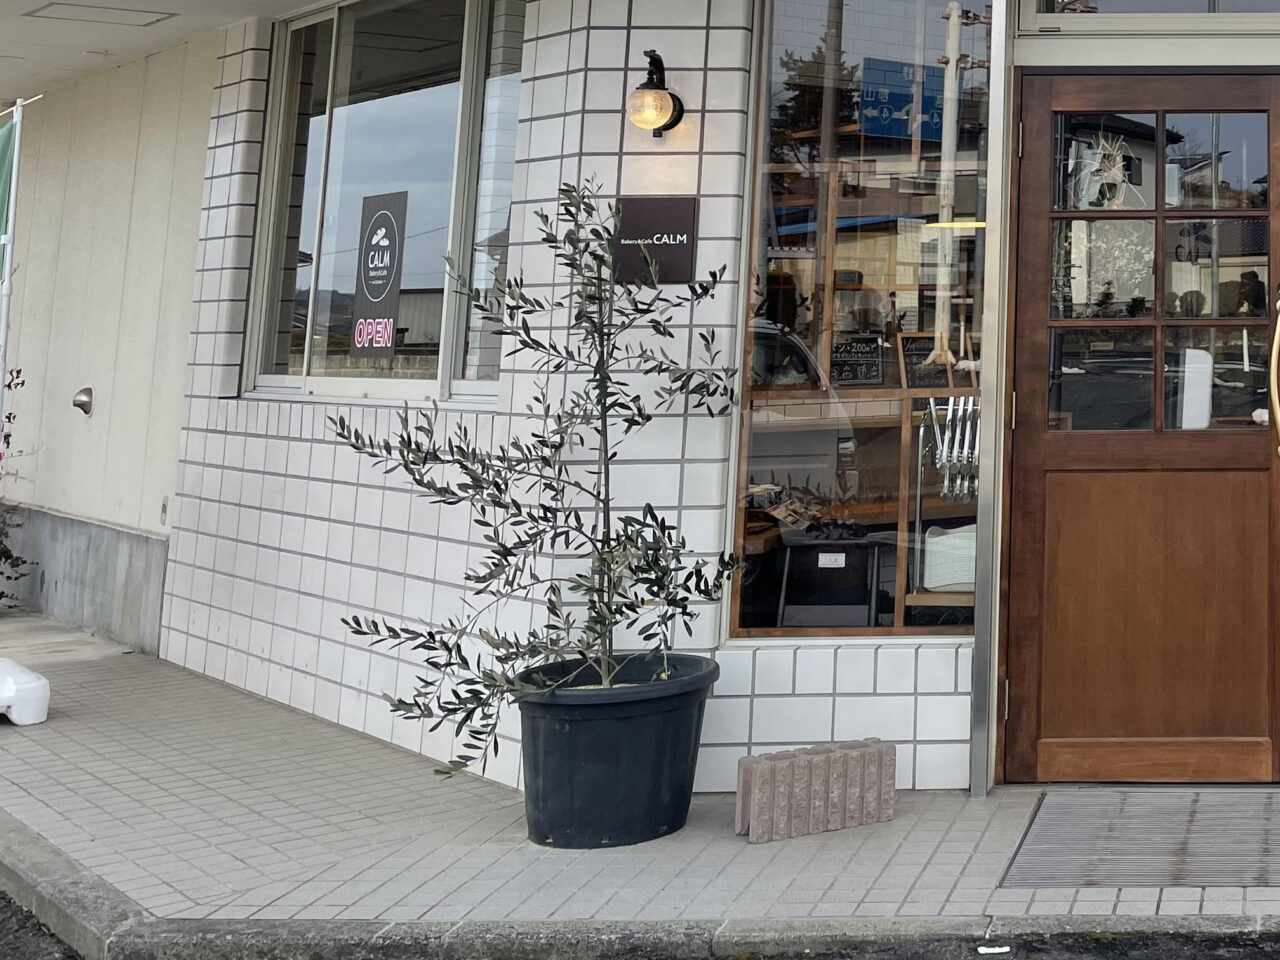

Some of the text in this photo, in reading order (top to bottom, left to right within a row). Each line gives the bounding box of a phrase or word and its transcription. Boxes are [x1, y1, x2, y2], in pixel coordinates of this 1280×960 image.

[653, 233, 687, 244] CALM
[368, 250, 390, 268] CALM
[355, 318, 394, 348] OPEN
